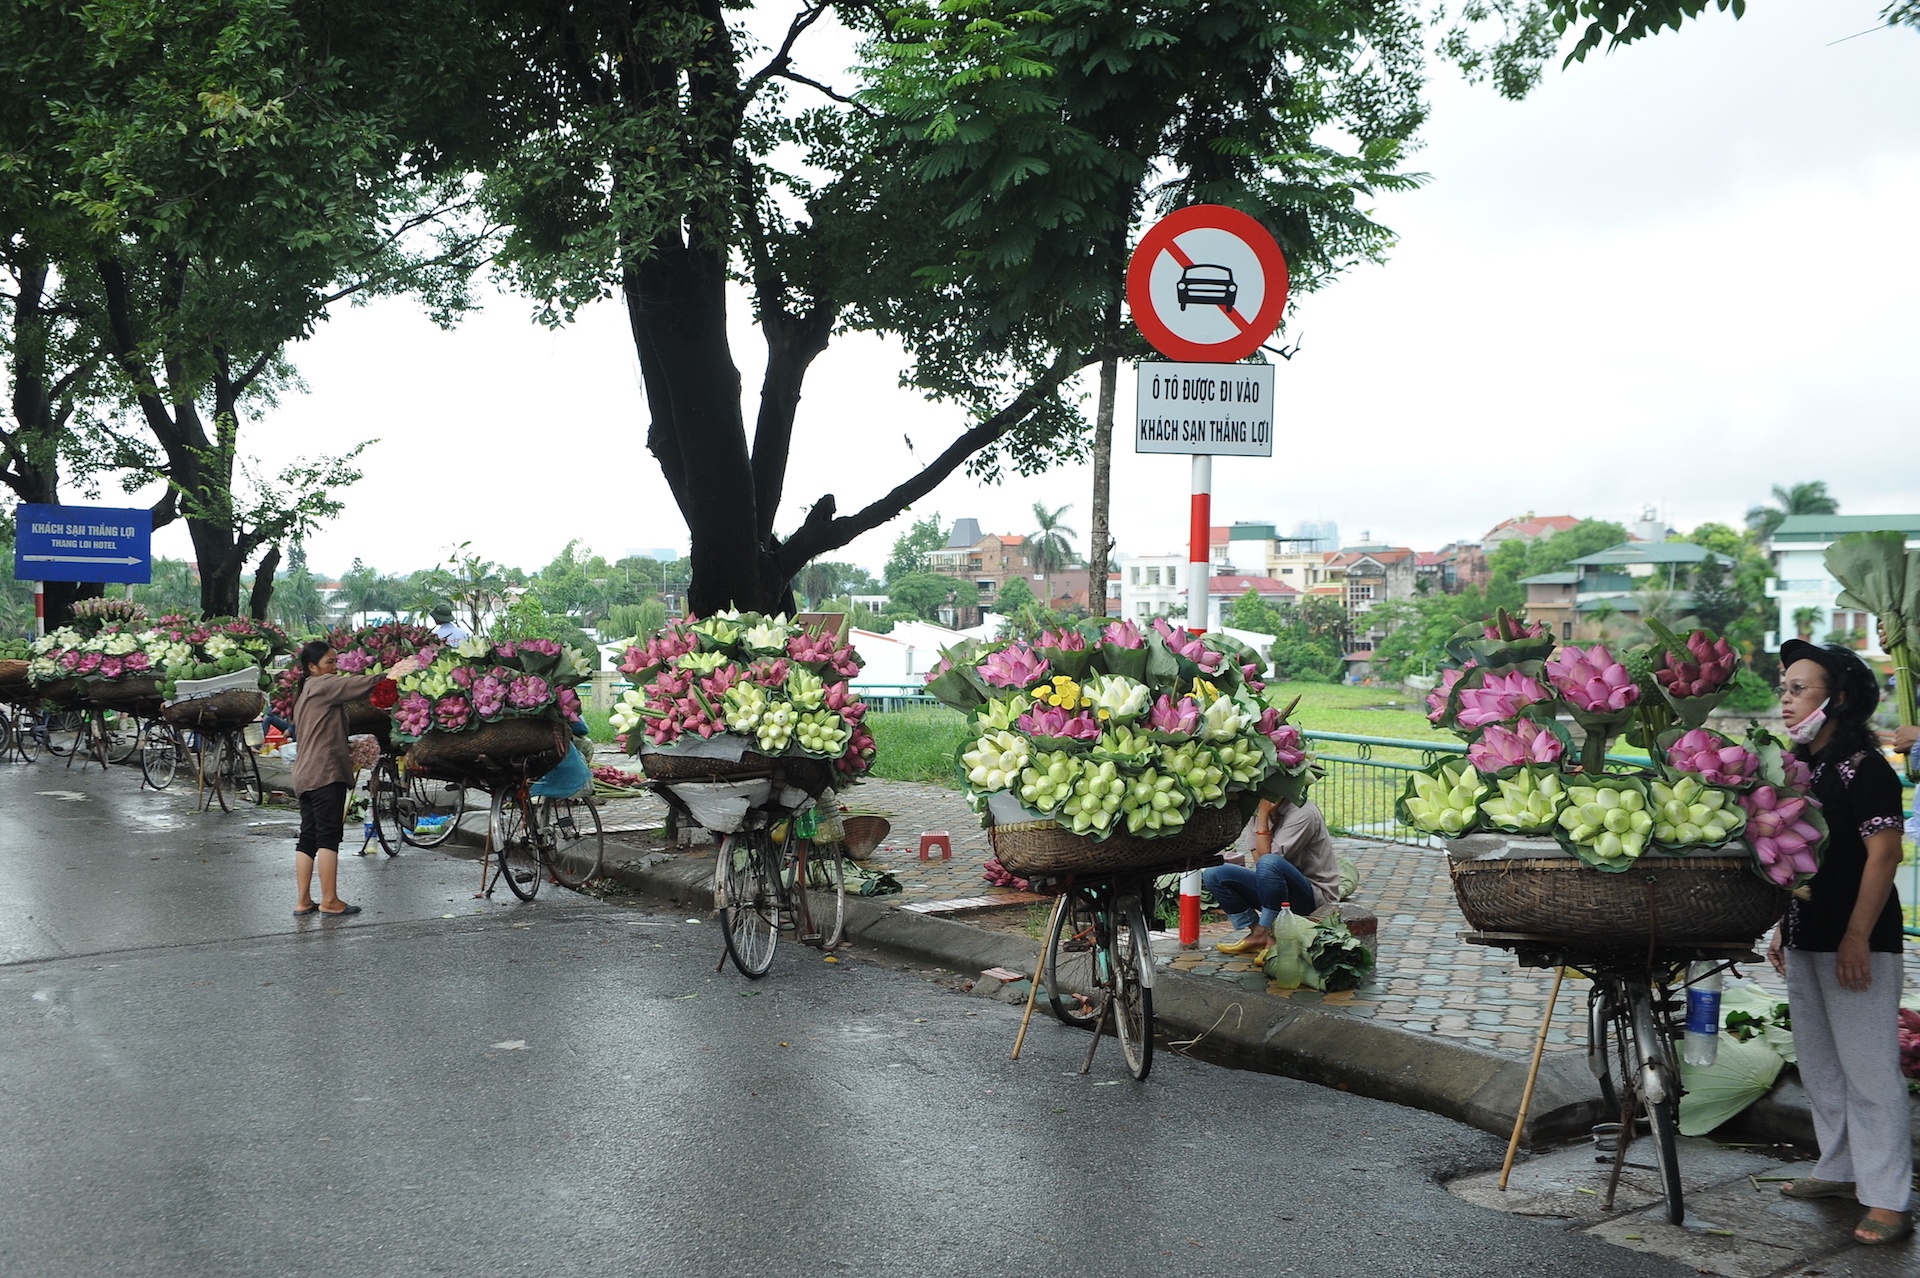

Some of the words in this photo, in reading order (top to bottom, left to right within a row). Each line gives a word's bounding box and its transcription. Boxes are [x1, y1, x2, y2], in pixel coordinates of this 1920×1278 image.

[1152, 374, 1160, 400] Ô
[1164, 374, 1179, 400] TÔ
[1182, 377, 1215, 404] ĐƯỢC
[1220, 380, 1232, 402] ĐI
[1236, 377, 1260, 403] VÀO
[1140, 415, 1179, 441] KHÁCH
[1182, 420, 1206, 445] SẠN
[1209, 414, 1247, 443] THẮNG
[1251, 421, 1269, 446] LỢI
[31, 521, 64, 535] KHÁCH
[65, 525, 86, 537] SẠN
[88, 522, 119, 537] THẮNG
[120, 526, 136, 539] LỢI
[51, 538, 78, 548] THANG
[79, 540, 92, 549] LOI
[93, 541, 117, 550] HOTEL
